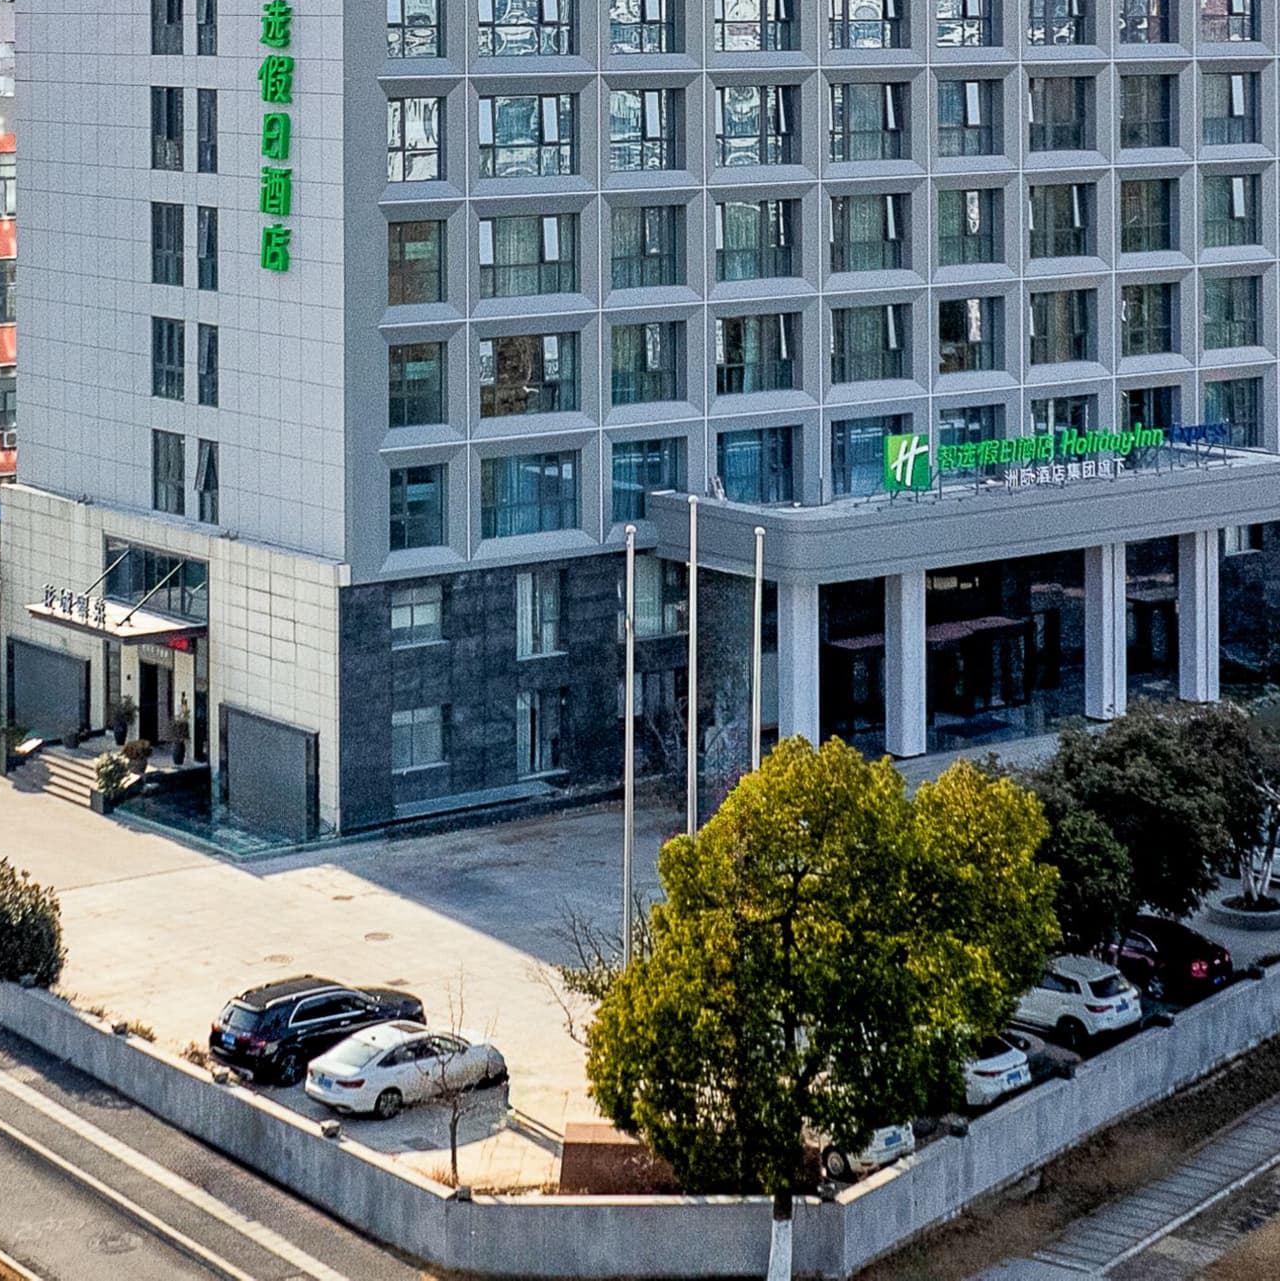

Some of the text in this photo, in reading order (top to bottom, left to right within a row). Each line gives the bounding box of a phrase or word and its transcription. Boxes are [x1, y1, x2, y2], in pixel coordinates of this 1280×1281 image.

[938, 433, 1055, 471] 智选假日酒店
[1061, 428, 1132, 456] Holiday
[1133, 423, 1164, 448] Inn
